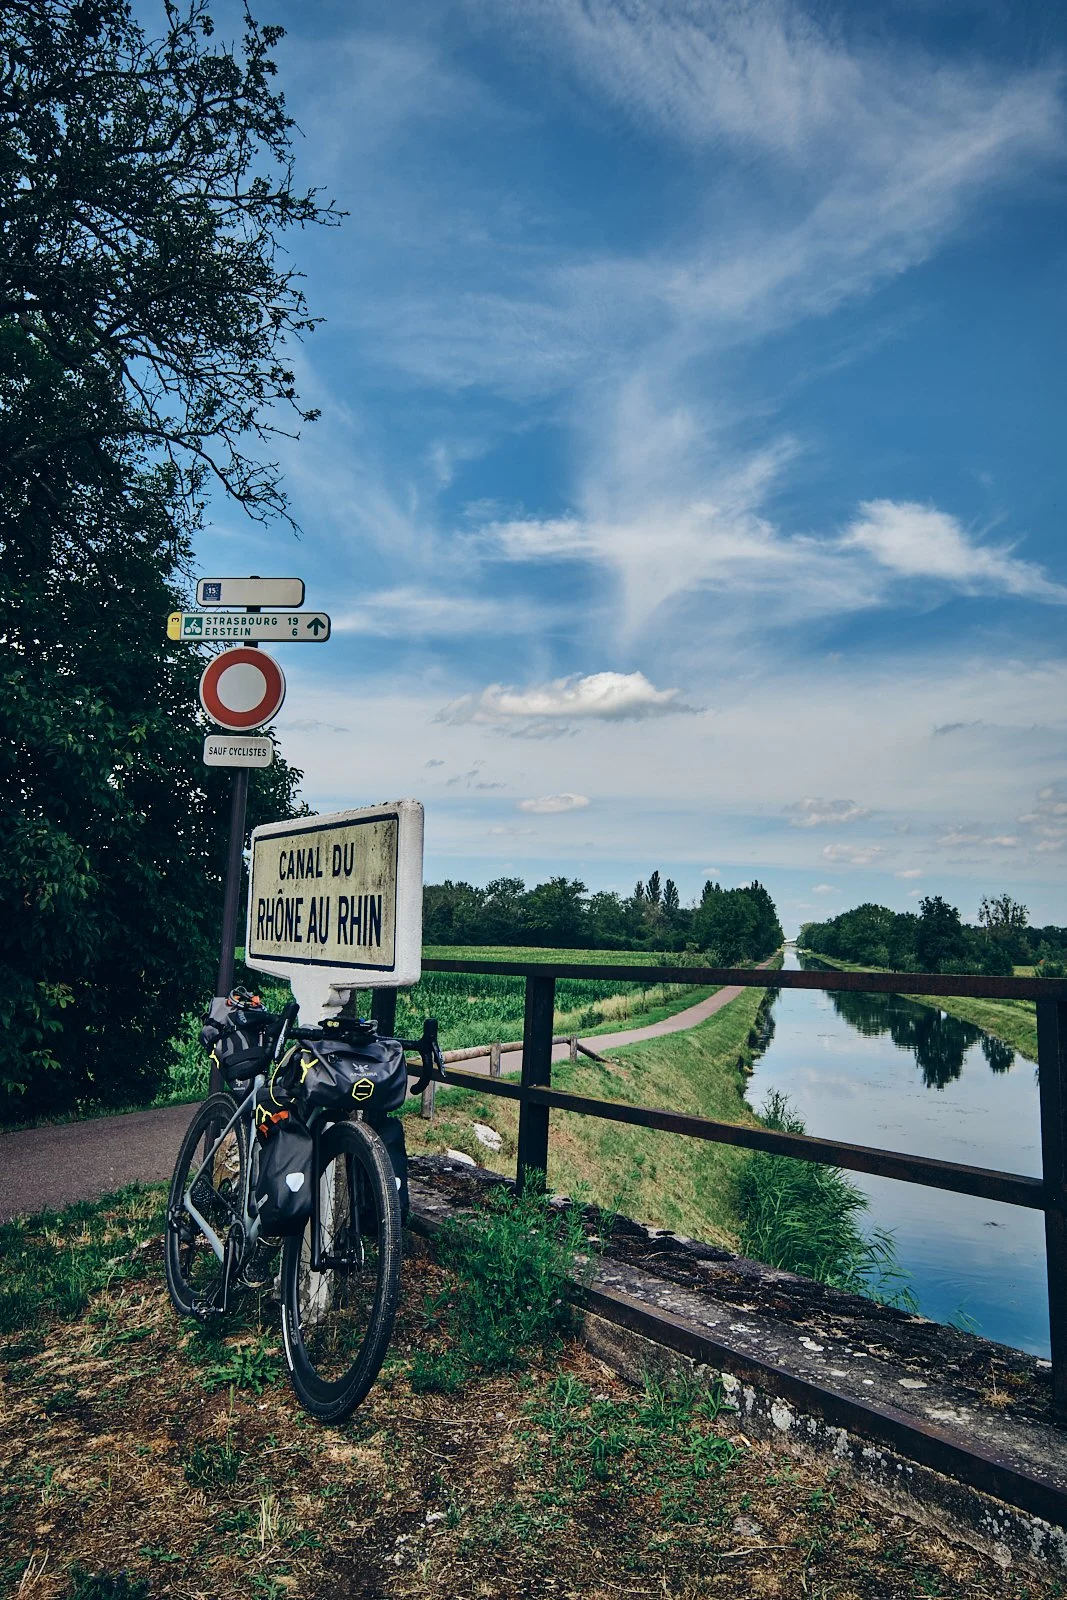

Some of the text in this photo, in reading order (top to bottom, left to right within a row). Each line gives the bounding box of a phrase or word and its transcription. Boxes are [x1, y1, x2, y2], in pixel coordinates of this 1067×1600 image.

[206, 617, 299, 626] STRASBOURG 19
[205, 627, 298, 636] ERSTEIN 6
[208, 746, 267, 757] SAUF CYCLISTES
[279, 842, 355, 880] CANAL DU
[256, 889, 382, 947] RHÔNE AU RHIN
